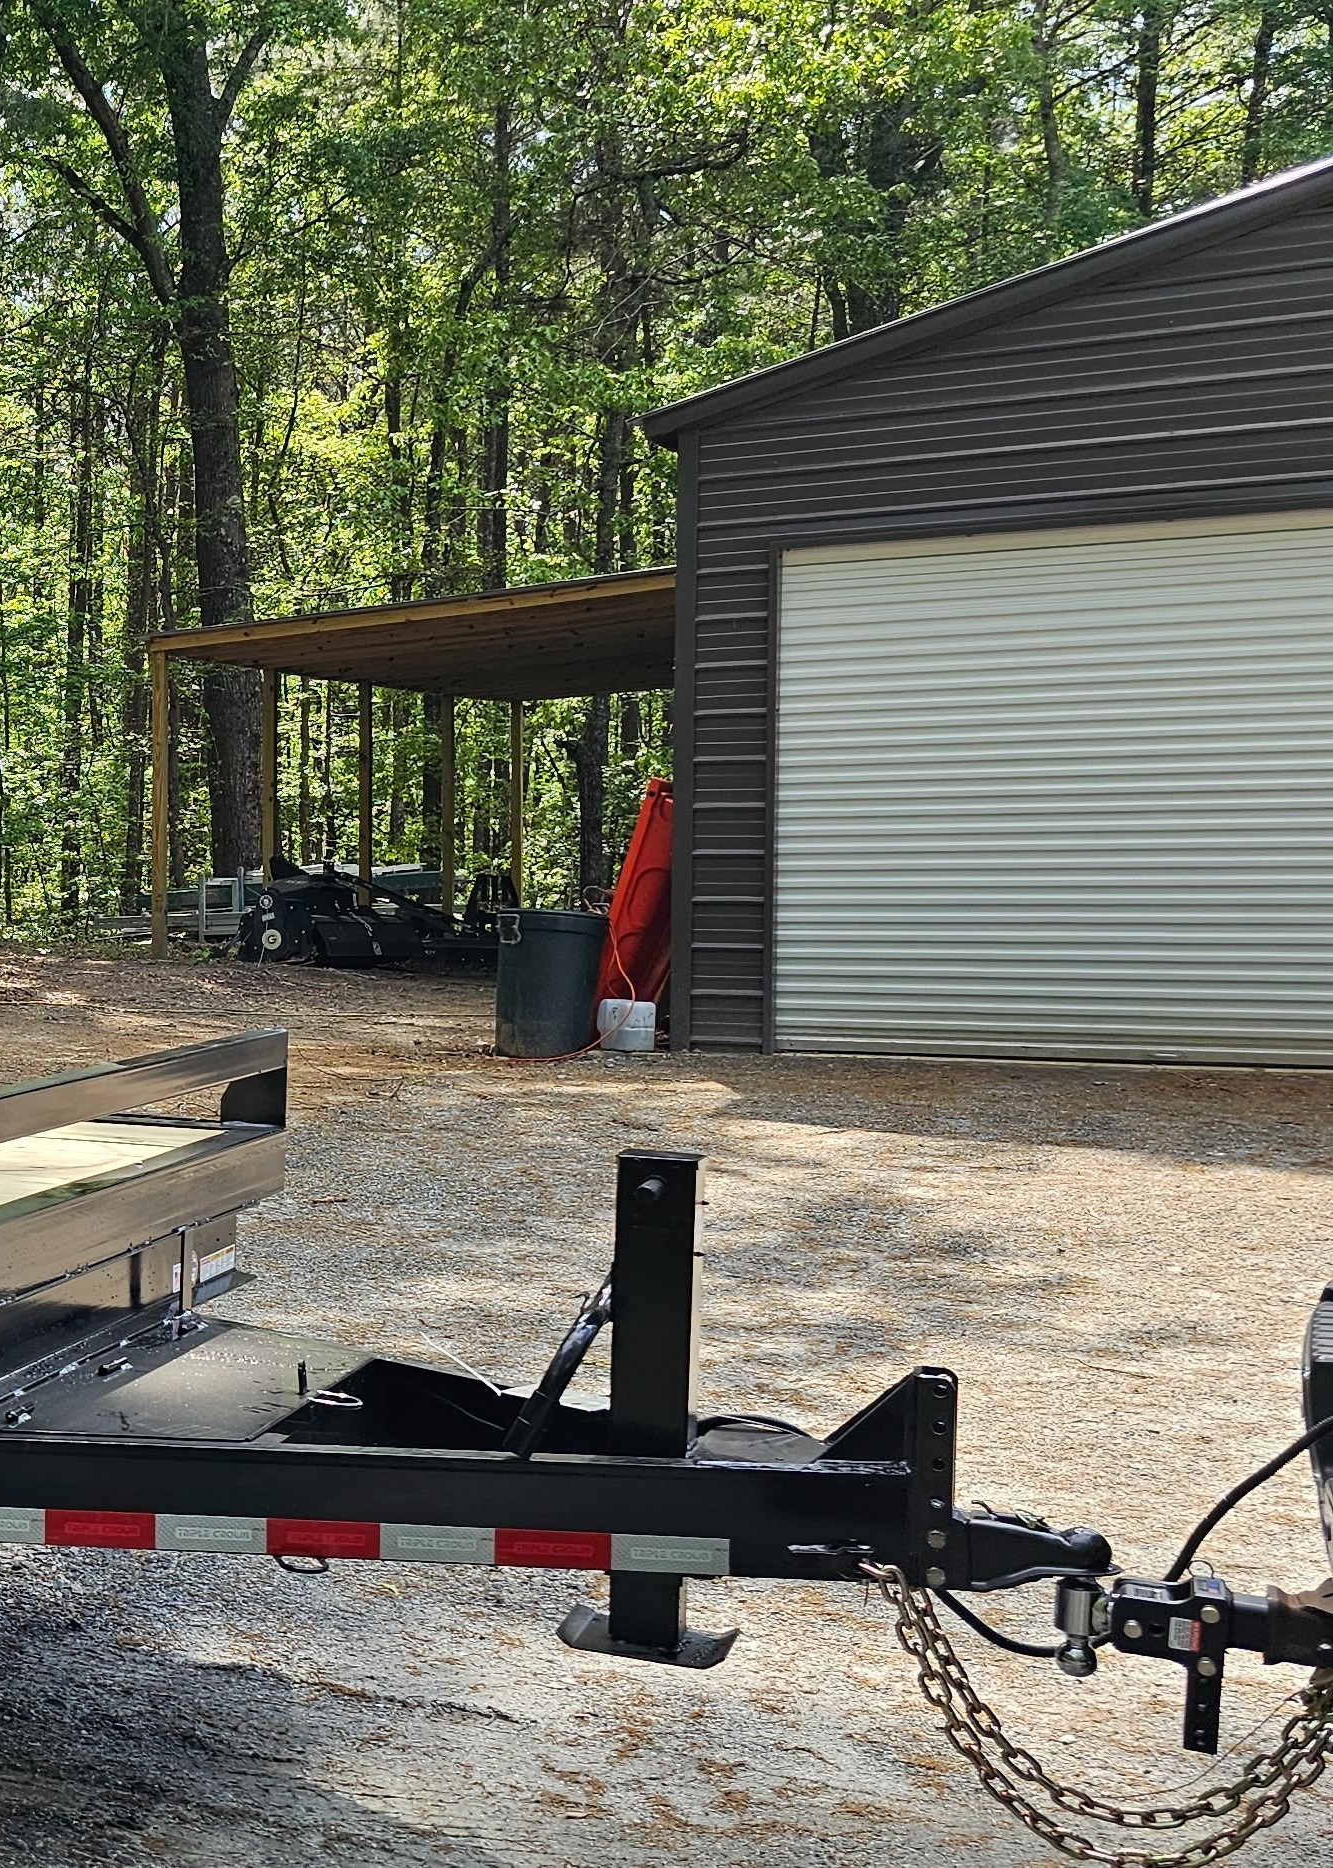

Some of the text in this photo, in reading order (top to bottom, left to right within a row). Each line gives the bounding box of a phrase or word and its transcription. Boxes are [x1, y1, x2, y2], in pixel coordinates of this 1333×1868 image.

[178, 1528, 250, 1540] TRIPLE CROWN
[401, 1537, 474, 1550] TRIPLE CROWN
[633, 1548, 709, 1561] TRIPLE CROWN
